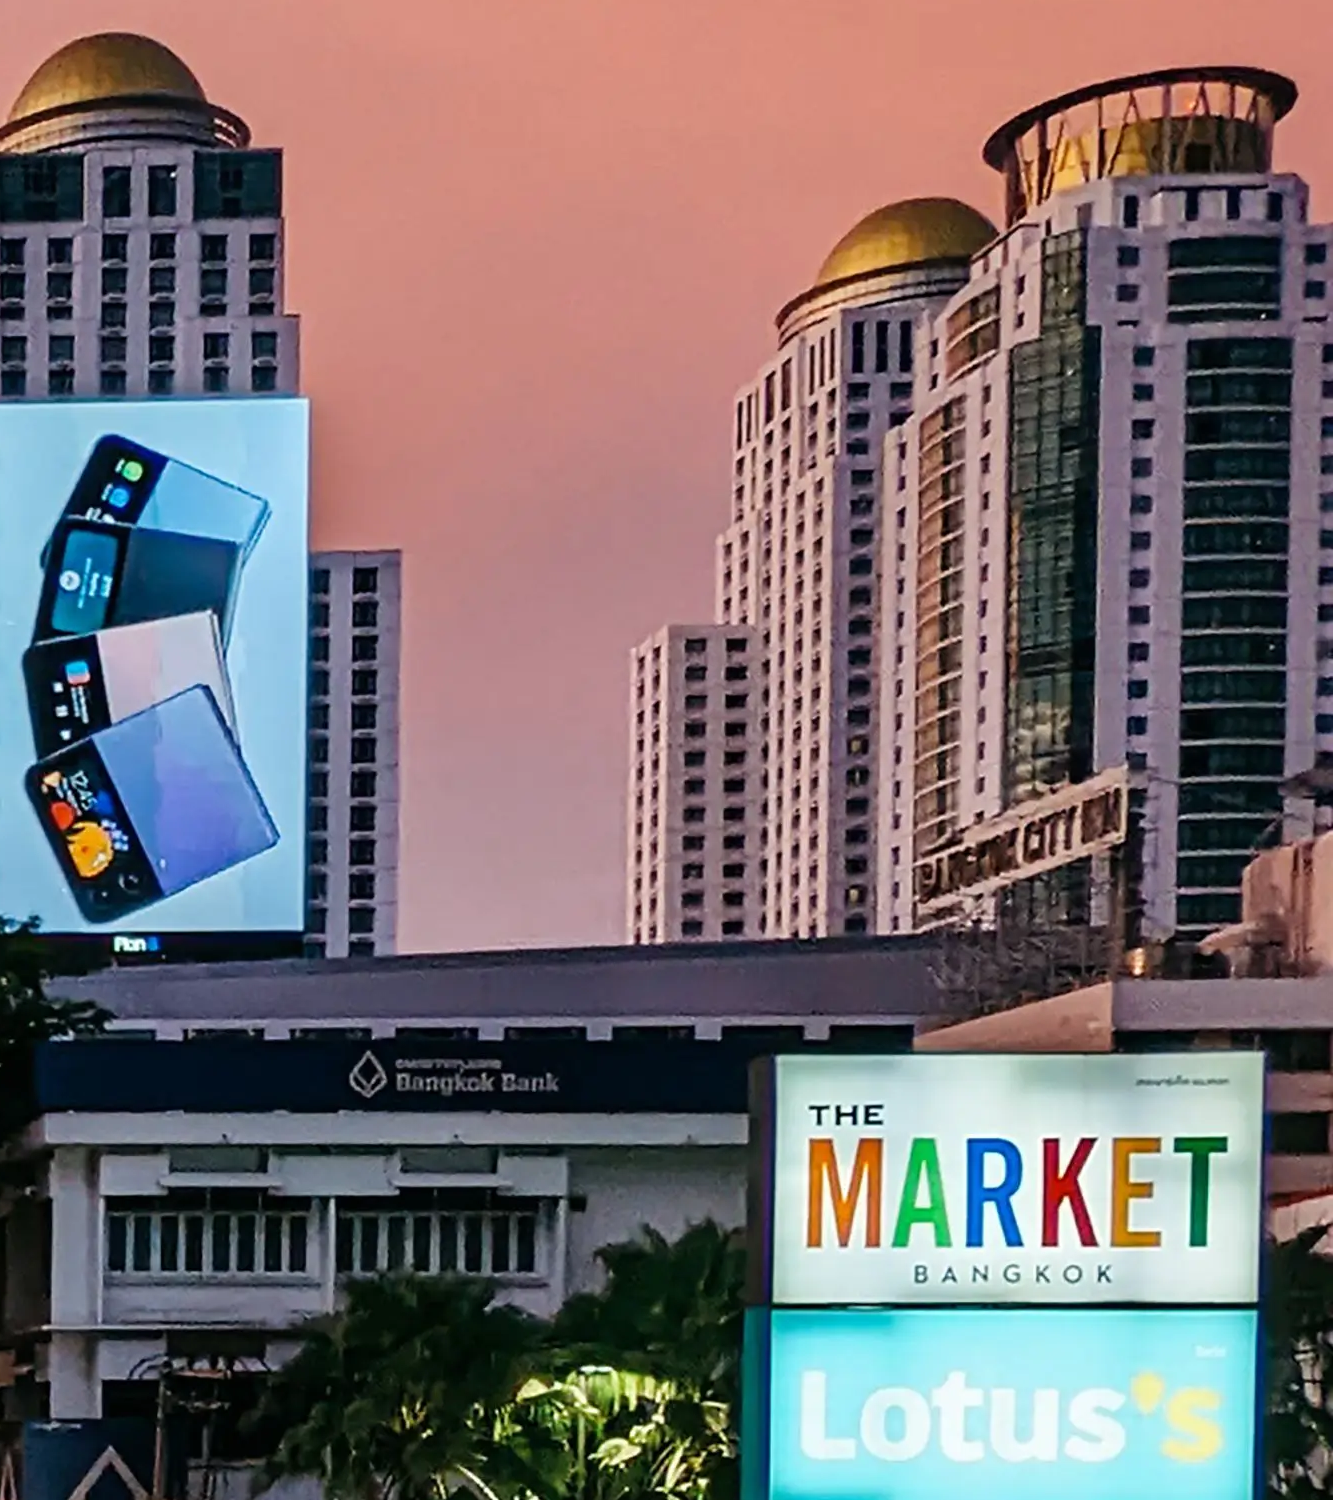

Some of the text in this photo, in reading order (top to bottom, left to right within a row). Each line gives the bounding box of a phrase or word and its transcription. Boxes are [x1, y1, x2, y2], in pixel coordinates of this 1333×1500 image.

[1023, 804, 1079, 864] CITY
[395, 1071, 560, 1096] Bangkok Bank
[808, 1104, 885, 1126] THE
[805, 1136, 1229, 1249] MARKET
[913, 1264, 1114, 1285] BANGKOK
[799, 1370, 1225, 1463] Lotus's
